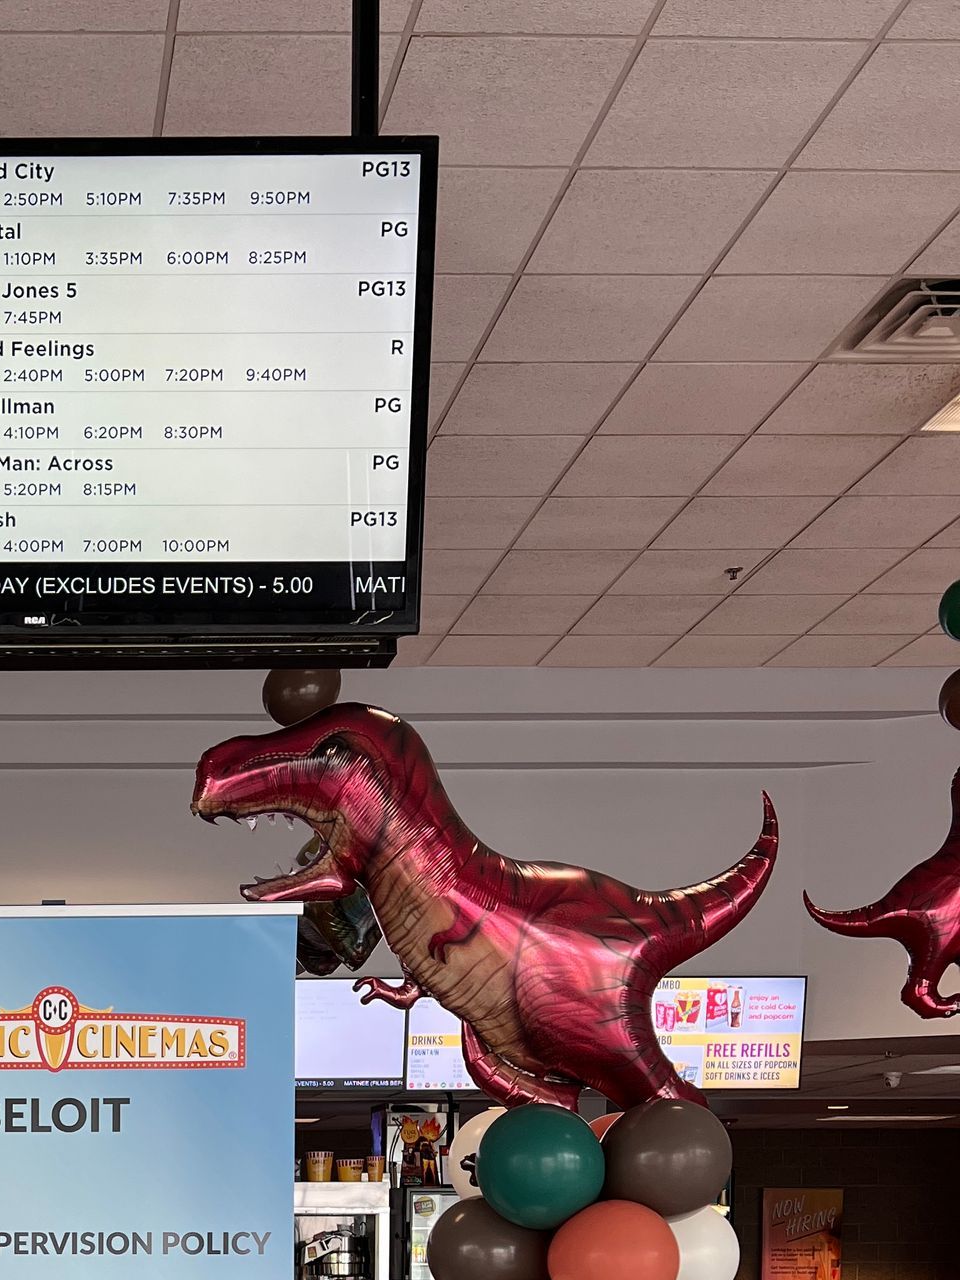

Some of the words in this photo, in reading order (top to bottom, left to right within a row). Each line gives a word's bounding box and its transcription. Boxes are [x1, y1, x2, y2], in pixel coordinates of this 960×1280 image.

[15, 162, 55, 183] City
[362, 161, 410, 178] PG13
[3, 192, 63, 206] 2:50PM
[86, 192, 141, 206] 5:10PM
[168, 191, 225, 205] 7:35PM
[250, 191, 310, 205] 9:50PM
[381, 221, 408, 237] PG
[3, 252, 55, 266] 1:10PM
[85, 251, 142, 265] 3:35PM
[167, 251, 228, 265] 6:00PM
[248, 251, 306, 265] 8:25PM
[1, 282, 59, 299] Jones
[66, 282, 77, 298] 5
[358, 280, 406, 297] PG13
[4, 311, 61, 324] 7:45PM
[12, 340, 94, 360] Feelings
[391, 339, 404, 355] R
[3, 369, 63, 382] 2:40PM
[84, 368, 145, 382] 5:00PM
[165, 368, 223, 382] 7:20PM
[246, 368, 306, 382] 9:40PM
[375, 397, 401, 413] PG
[3, 426, 59, 440] 4:10PM
[84, 426, 142, 439] 6:20PM
[164, 426, 222, 439] 8:30PM
[47, 456, 113, 471] Across
[373, 455, 399, 470] PG
[4, 483, 61, 496] 5:20PM
[83, 483, 136, 496] 8:15PM
[351, 511, 397, 527] PG13
[3, 539, 64, 553] 4:00PM
[83, 539, 142, 553] 7:00PM
[162, 539, 229, 553] 10:00PM
[36, 577, 155, 598] (EXCLUDES
[162, 577, 254, 598] EVENTS)
[273, 576, 313, 594] 5.00
[355, 576, 406, 593] MATI
[24, 616, 46, 624] RCA
[77, 1024, 230, 1058] CINEMAS
[411, 1036, 444, 1046] DRINKS
[706, 1043, 737, 1058] FREE
[741, 1043, 791, 1058] REFILLS
[705, 1061, 714, 1069] ON
[717, 1061, 729, 1069] ALL
[732, 1061, 752, 1069] SIZES
[754, 1061, 763, 1069] OF
[764, 1061, 798, 1069] POPCORN
[705, 1072, 722, 1080] SOFT
[724, 1072, 750, 1080] DRINKS
[760, 1072, 780, 1080] ICEES
[772, 1196, 805, 1219] NOW
[785, 1207, 836, 1238] HIRING
[163, 1231, 271, 1255] POLICY
